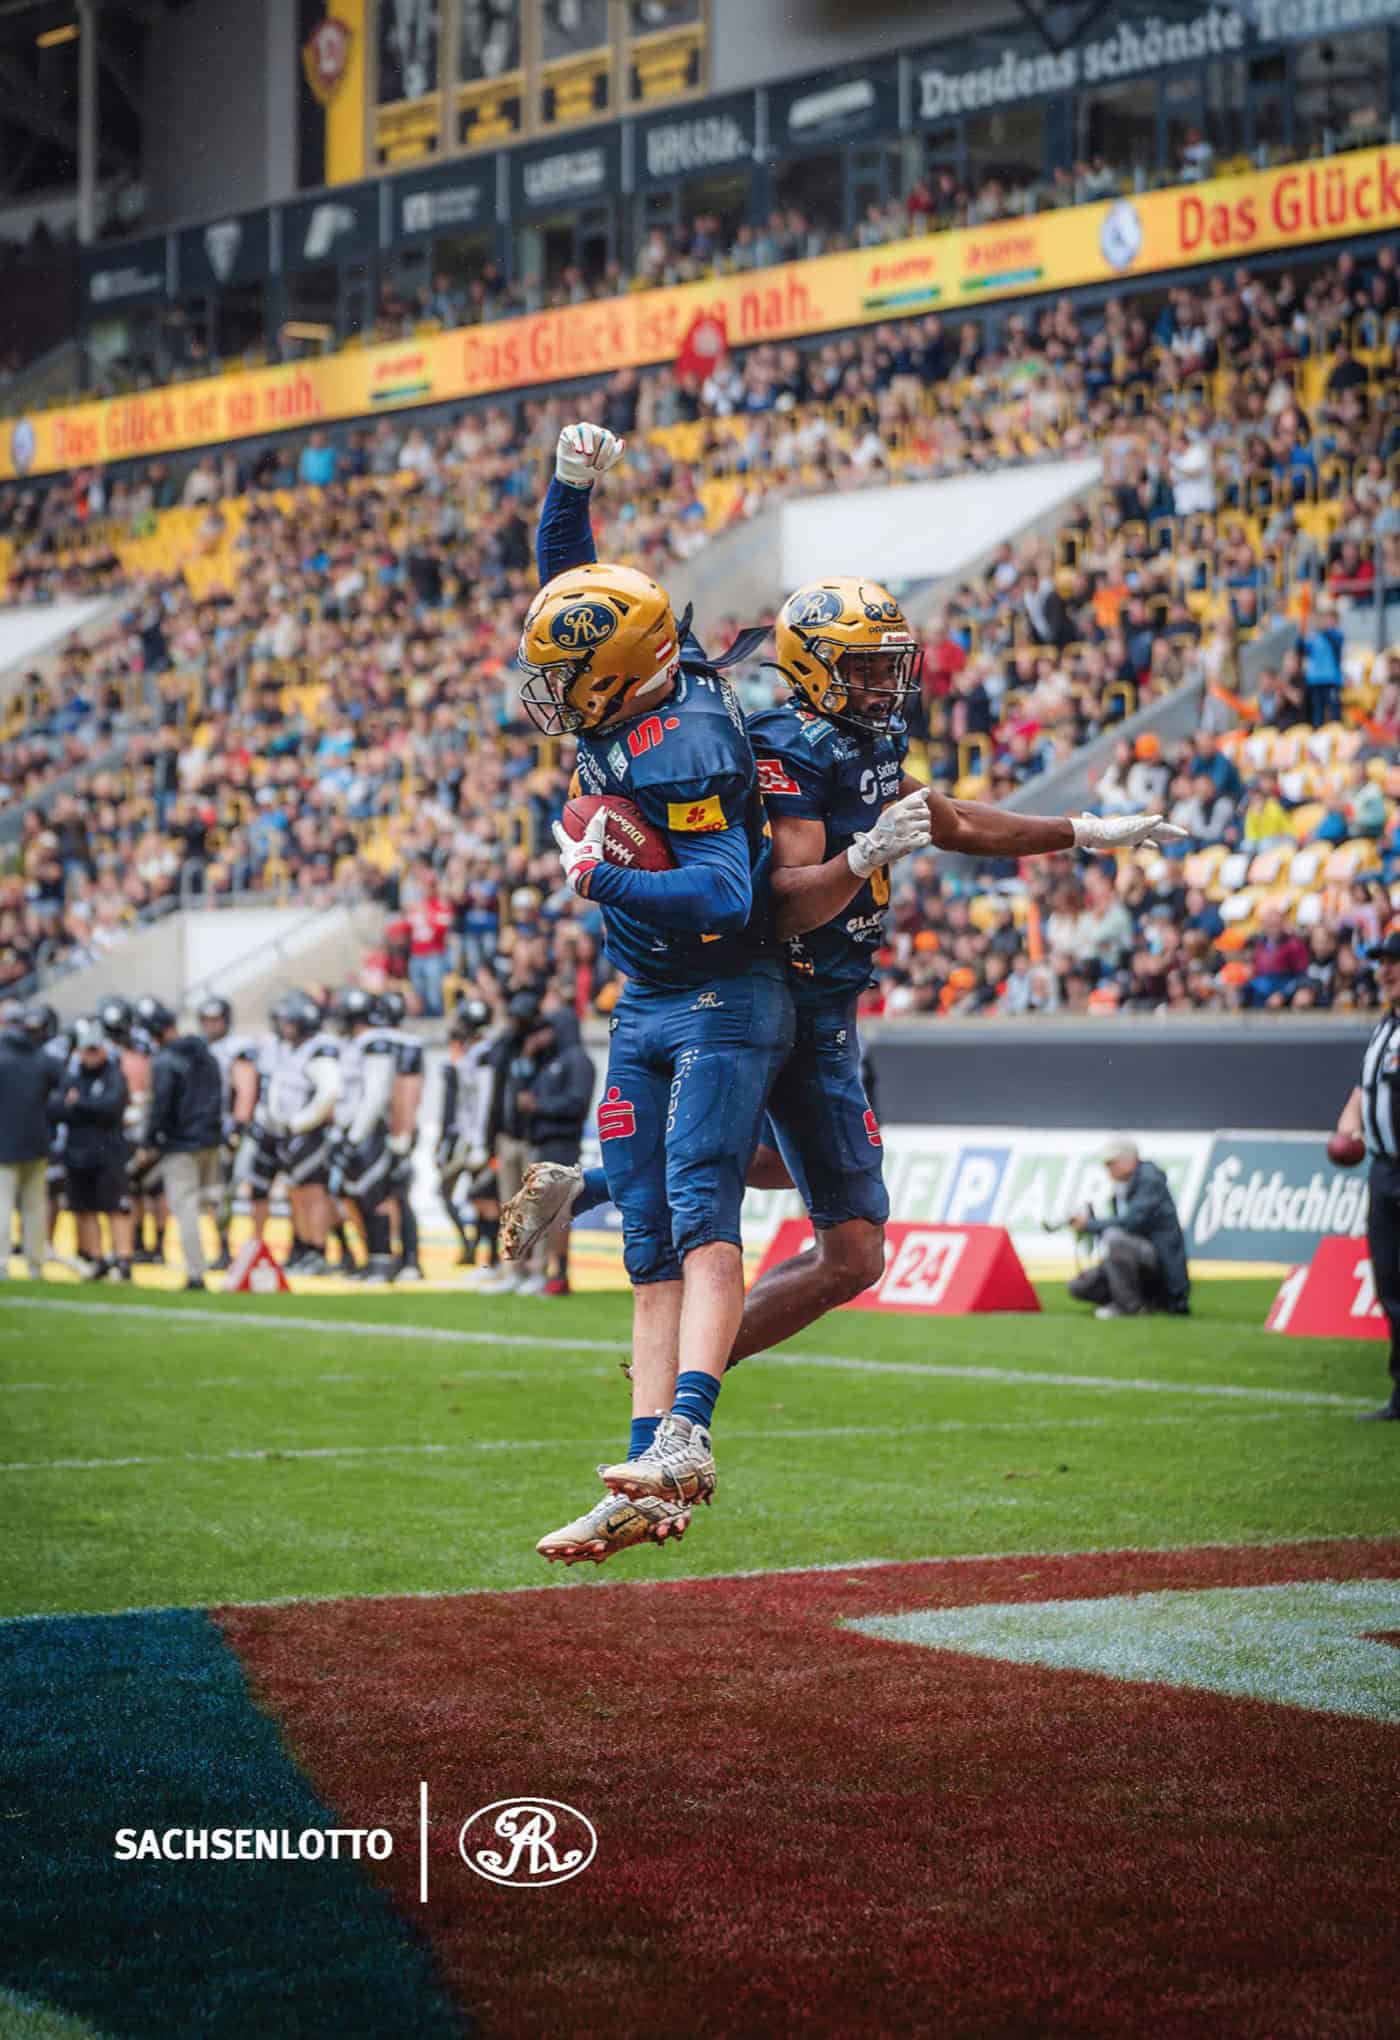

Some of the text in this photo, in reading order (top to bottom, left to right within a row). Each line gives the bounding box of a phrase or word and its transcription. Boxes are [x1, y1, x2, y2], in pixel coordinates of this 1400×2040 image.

[919, 48, 1077, 119] Dresdens
[1083, 8, 1245, 80] schönste
[1178, 154, 1400, 252] Das Glück
[463, 334, 520, 385] Das
[529, 316, 628, 376] Glück
